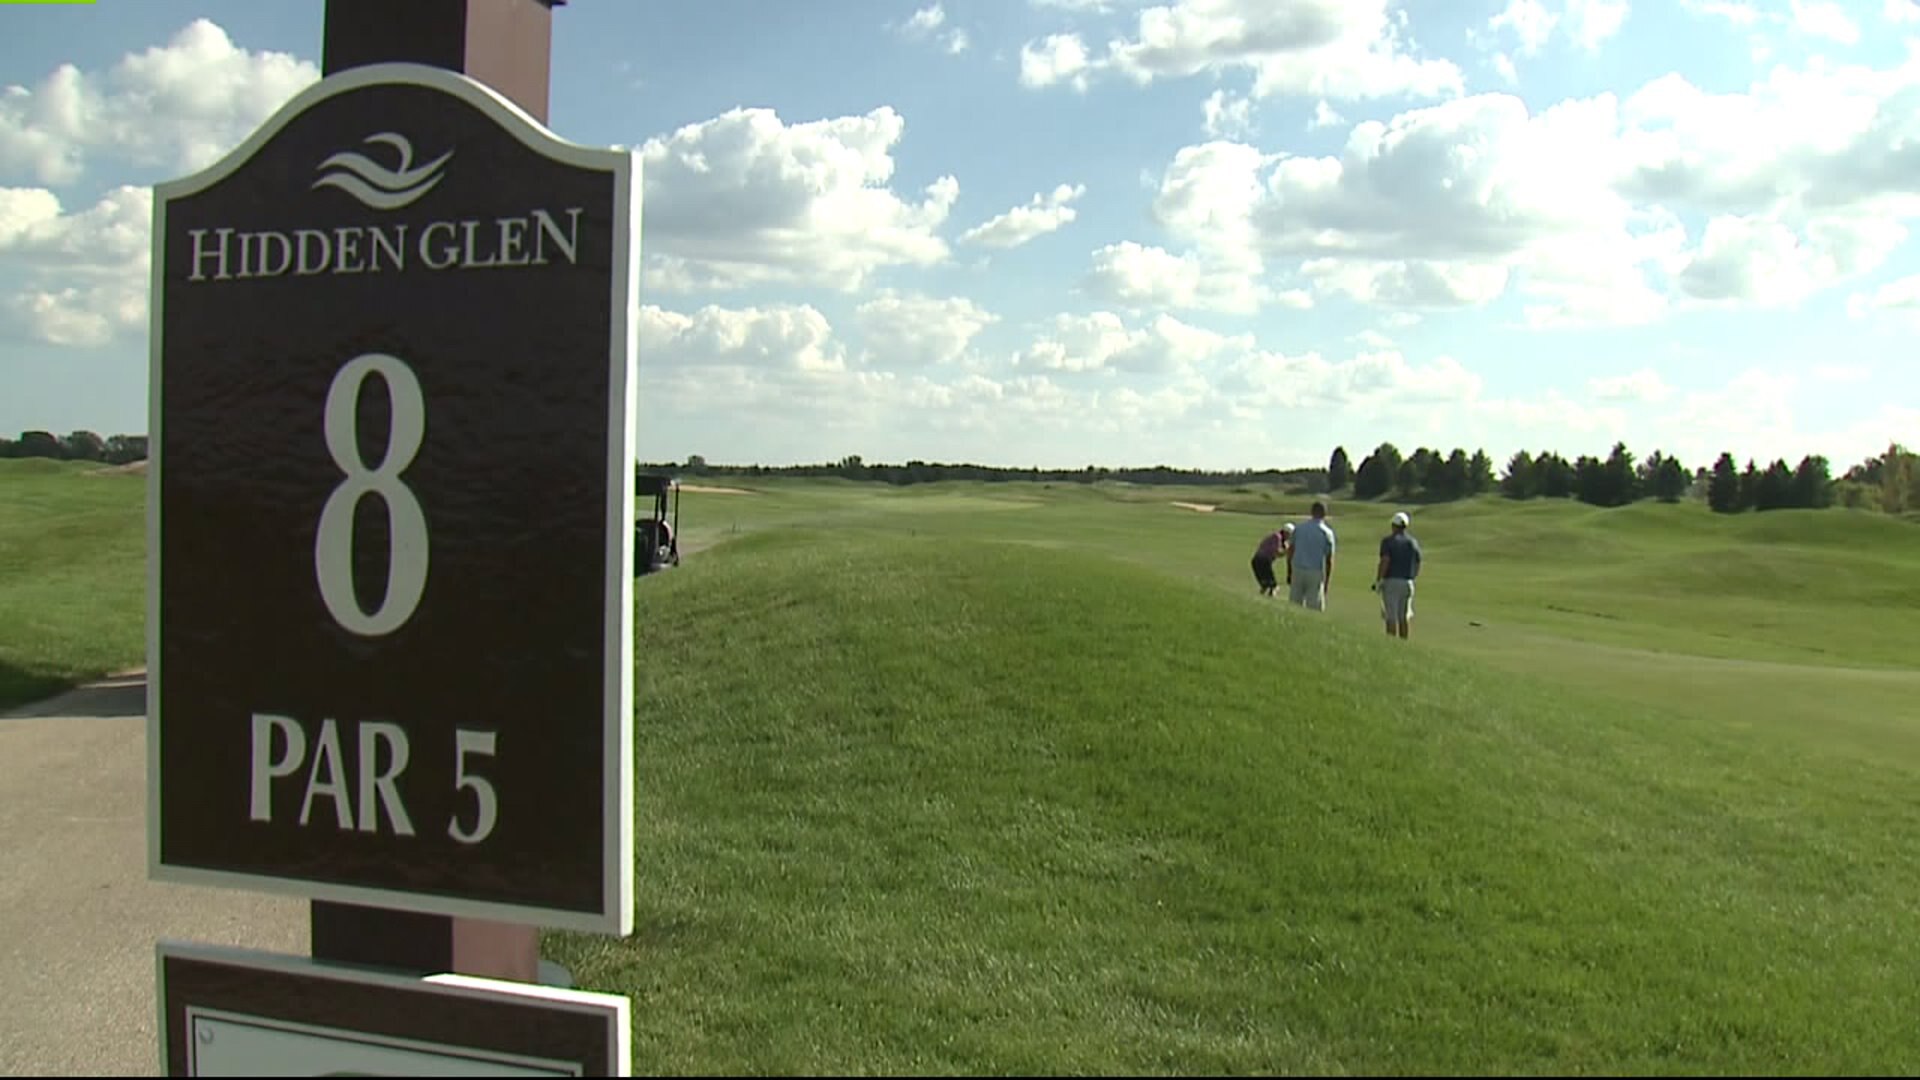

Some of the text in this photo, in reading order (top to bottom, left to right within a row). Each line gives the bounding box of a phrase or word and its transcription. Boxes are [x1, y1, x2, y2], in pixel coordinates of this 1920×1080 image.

[188, 208, 583, 281] HIDDEN GLEN
[315, 353, 429, 637] 8
[249, 713, 498, 843] PAR 5
